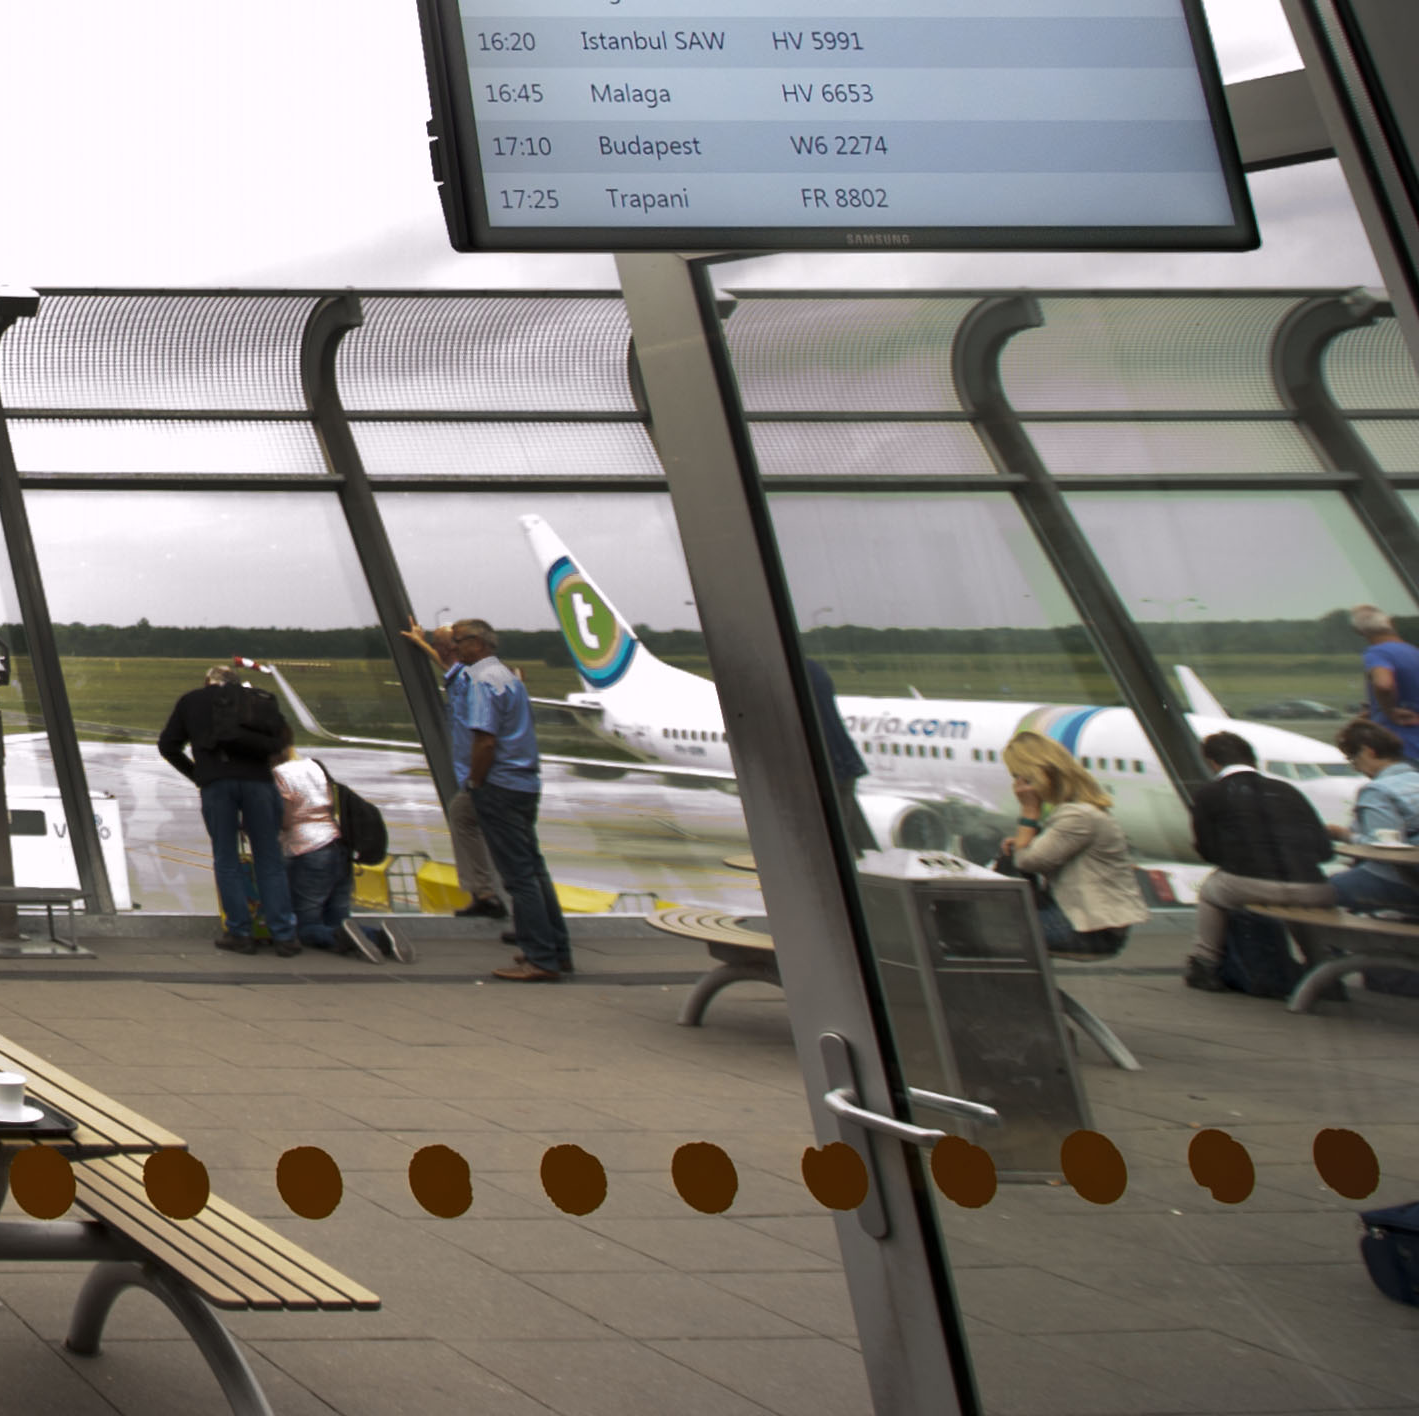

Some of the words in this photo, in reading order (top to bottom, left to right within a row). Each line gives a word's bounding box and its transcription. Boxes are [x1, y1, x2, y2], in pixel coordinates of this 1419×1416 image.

[485, 83, 544, 103] 16:45
[590, 82, 671, 109] Malaga
[781, 83, 813, 103] HV
[821, 83, 874, 103] 6653
[845, 233, 911, 246] SAMSUNG
[571, 592, 600, 649] t
[845, 710, 971, 740] avia.com
